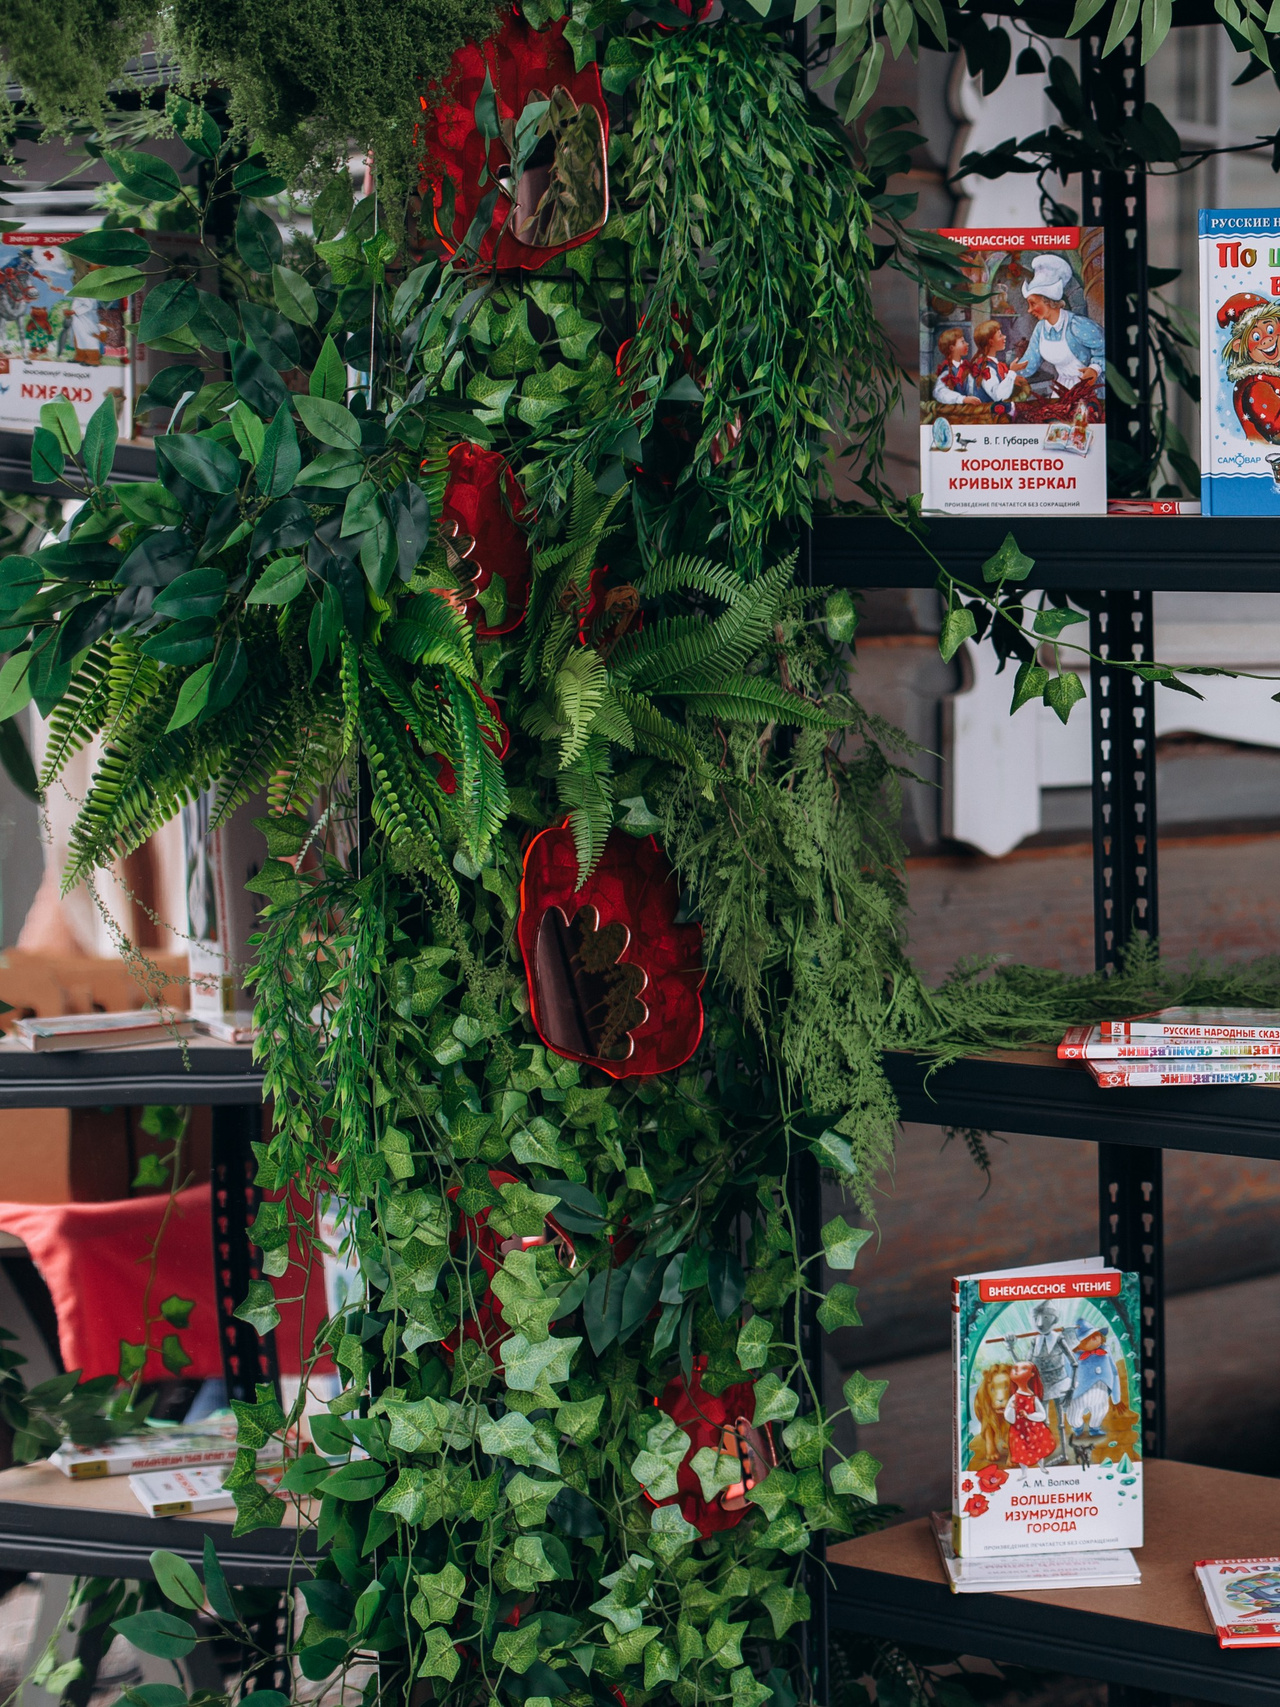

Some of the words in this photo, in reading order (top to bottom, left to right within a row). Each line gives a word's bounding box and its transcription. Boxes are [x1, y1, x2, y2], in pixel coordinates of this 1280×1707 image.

[1211, 218, 1270, 228] РУССКИЕ
[1031, 234, 1071, 245] ЧТЕНИЕ
[984, 437, 992, 445] В.
[995, 437, 1000, 445] Г.
[1003, 436, 1039, 447] Губарев
[961, 459, 1064, 471] КОРОЛЕВСТВО
[949, 477, 1013, 490] КРИВЫХ
[1018, 477, 1076, 489] ЗЕРКАЛ
[1163, 1027, 1201, 1035] РУССКИЕ
[1204, 1028, 1255, 1038] НАРОДНЫЕ
[988, 1283, 1066, 1297] ВНЕКЛАССНОЕ
[1072, 1281, 1111, 1292] ЧТЕНИЕ
[1048, 1479, 1080, 1487] Волков
[1011, 1492, 1092, 1506] ВОЛШЕБНИК
[1005, 1506, 1098, 1521] ИЗУМРУДНОГО
[1027, 1521, 1076, 1533] ГОРОДА
